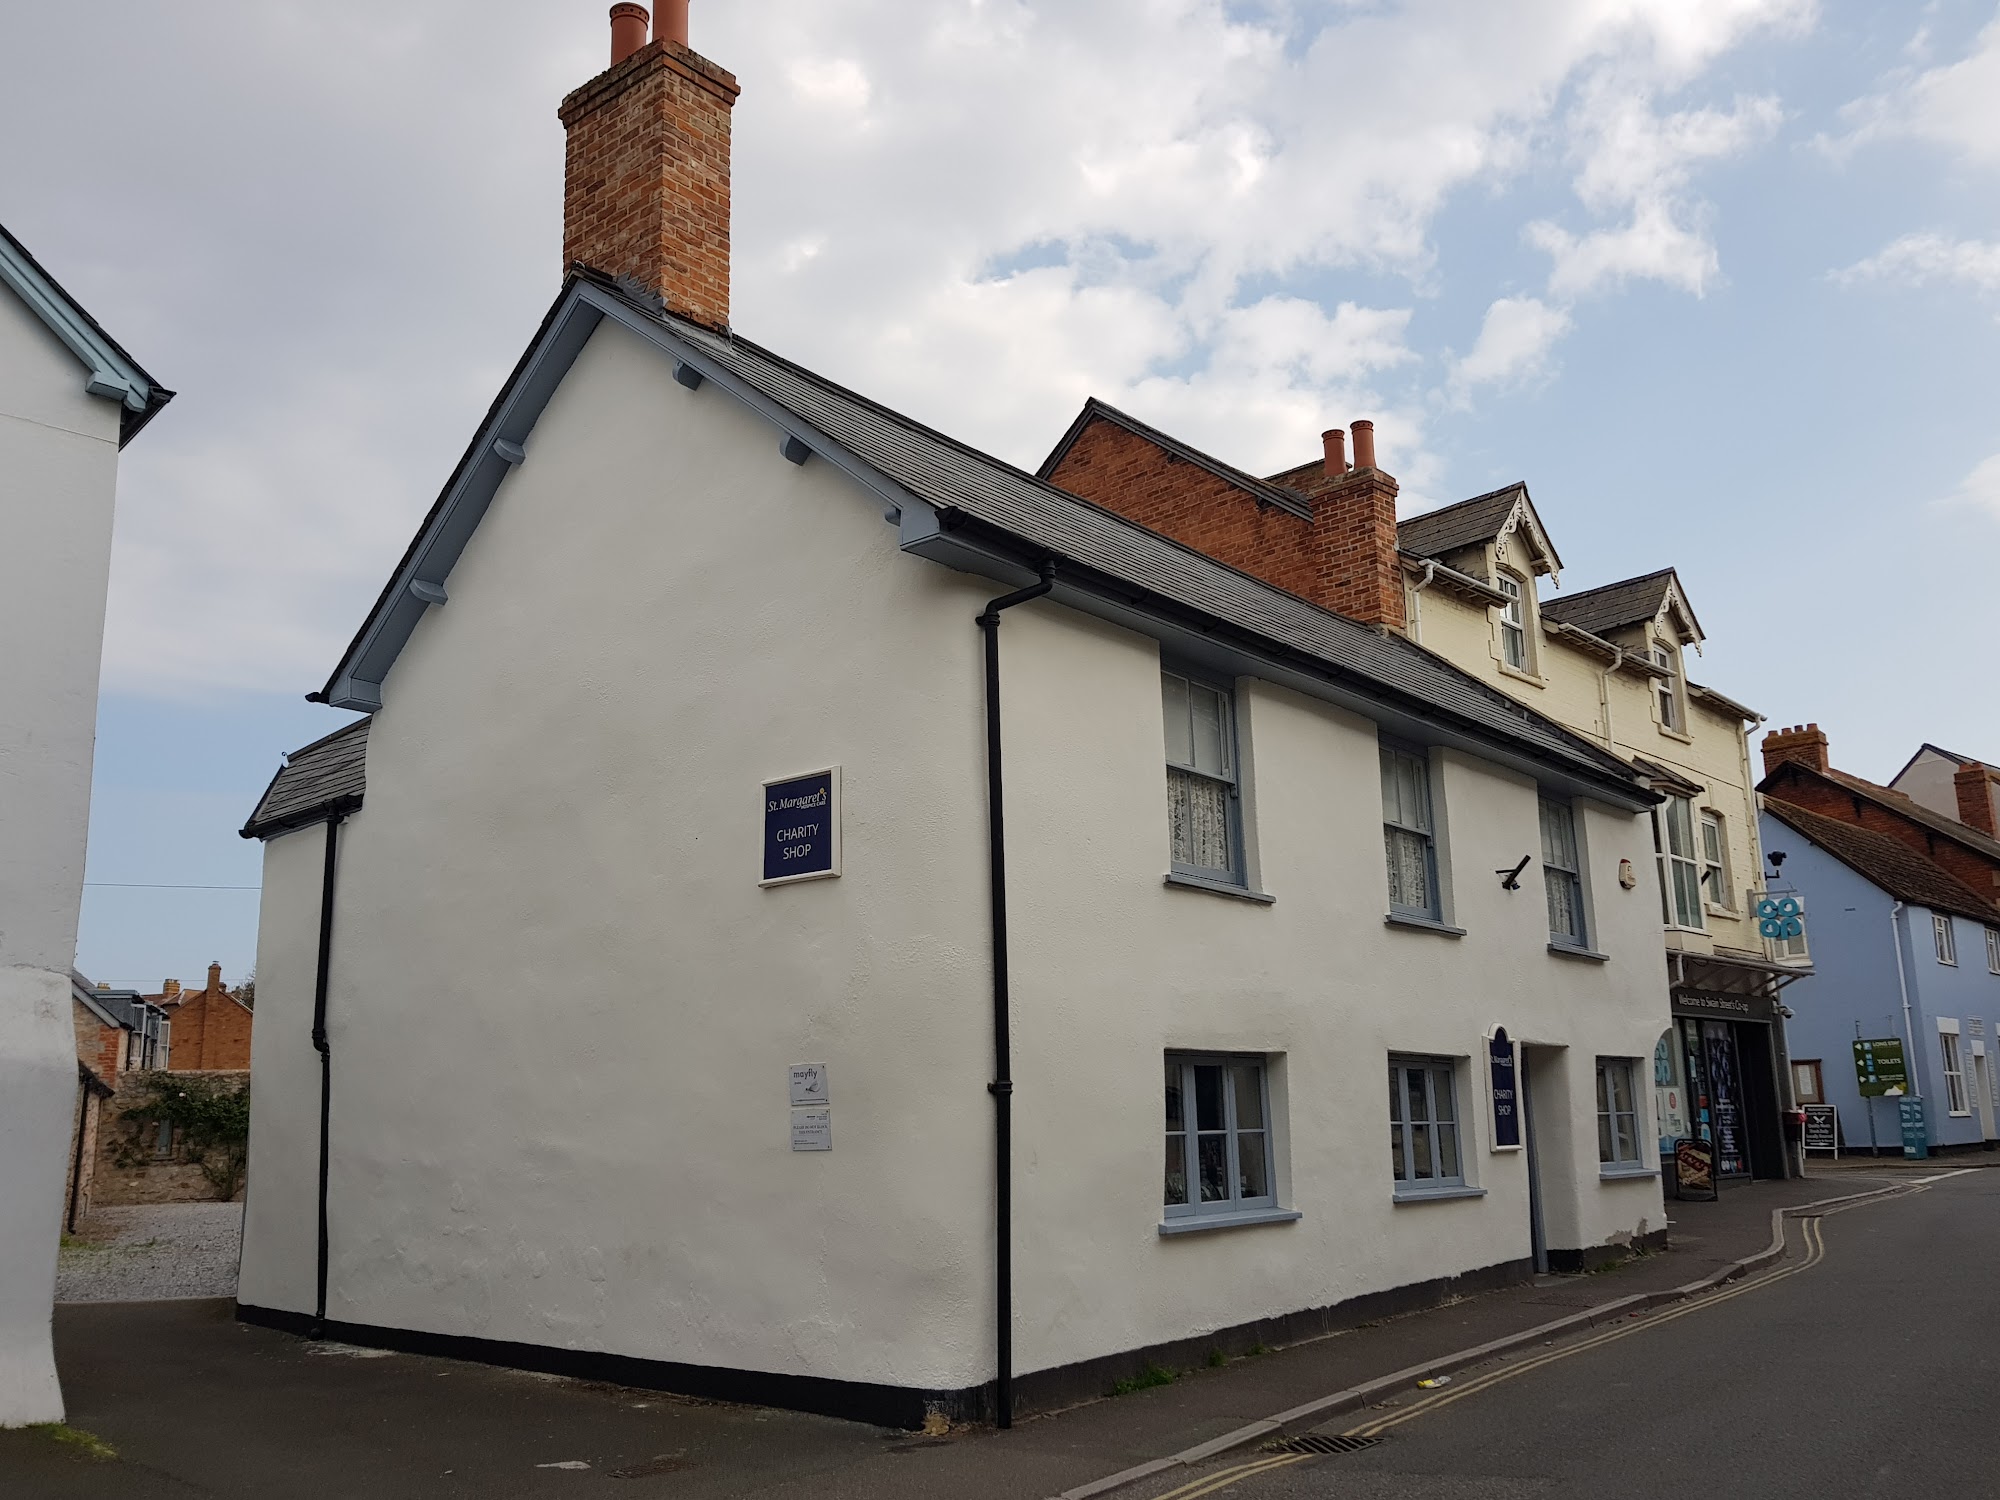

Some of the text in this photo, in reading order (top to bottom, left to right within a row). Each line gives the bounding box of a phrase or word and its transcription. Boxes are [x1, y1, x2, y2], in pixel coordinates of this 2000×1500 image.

[767, 790, 828, 812] St. Margaret's
[776, 823, 819, 842] CHARITY
[783, 843, 812, 860] SHOP
[1678, 993, 1700, 1006] Welcome
[1700, 997, 1706, 1007] to
[794, 1068, 818, 1079] mayfly
[1494, 1088, 1513, 1099] CHARITY
[1498, 1105, 1511, 1115] SHOP
